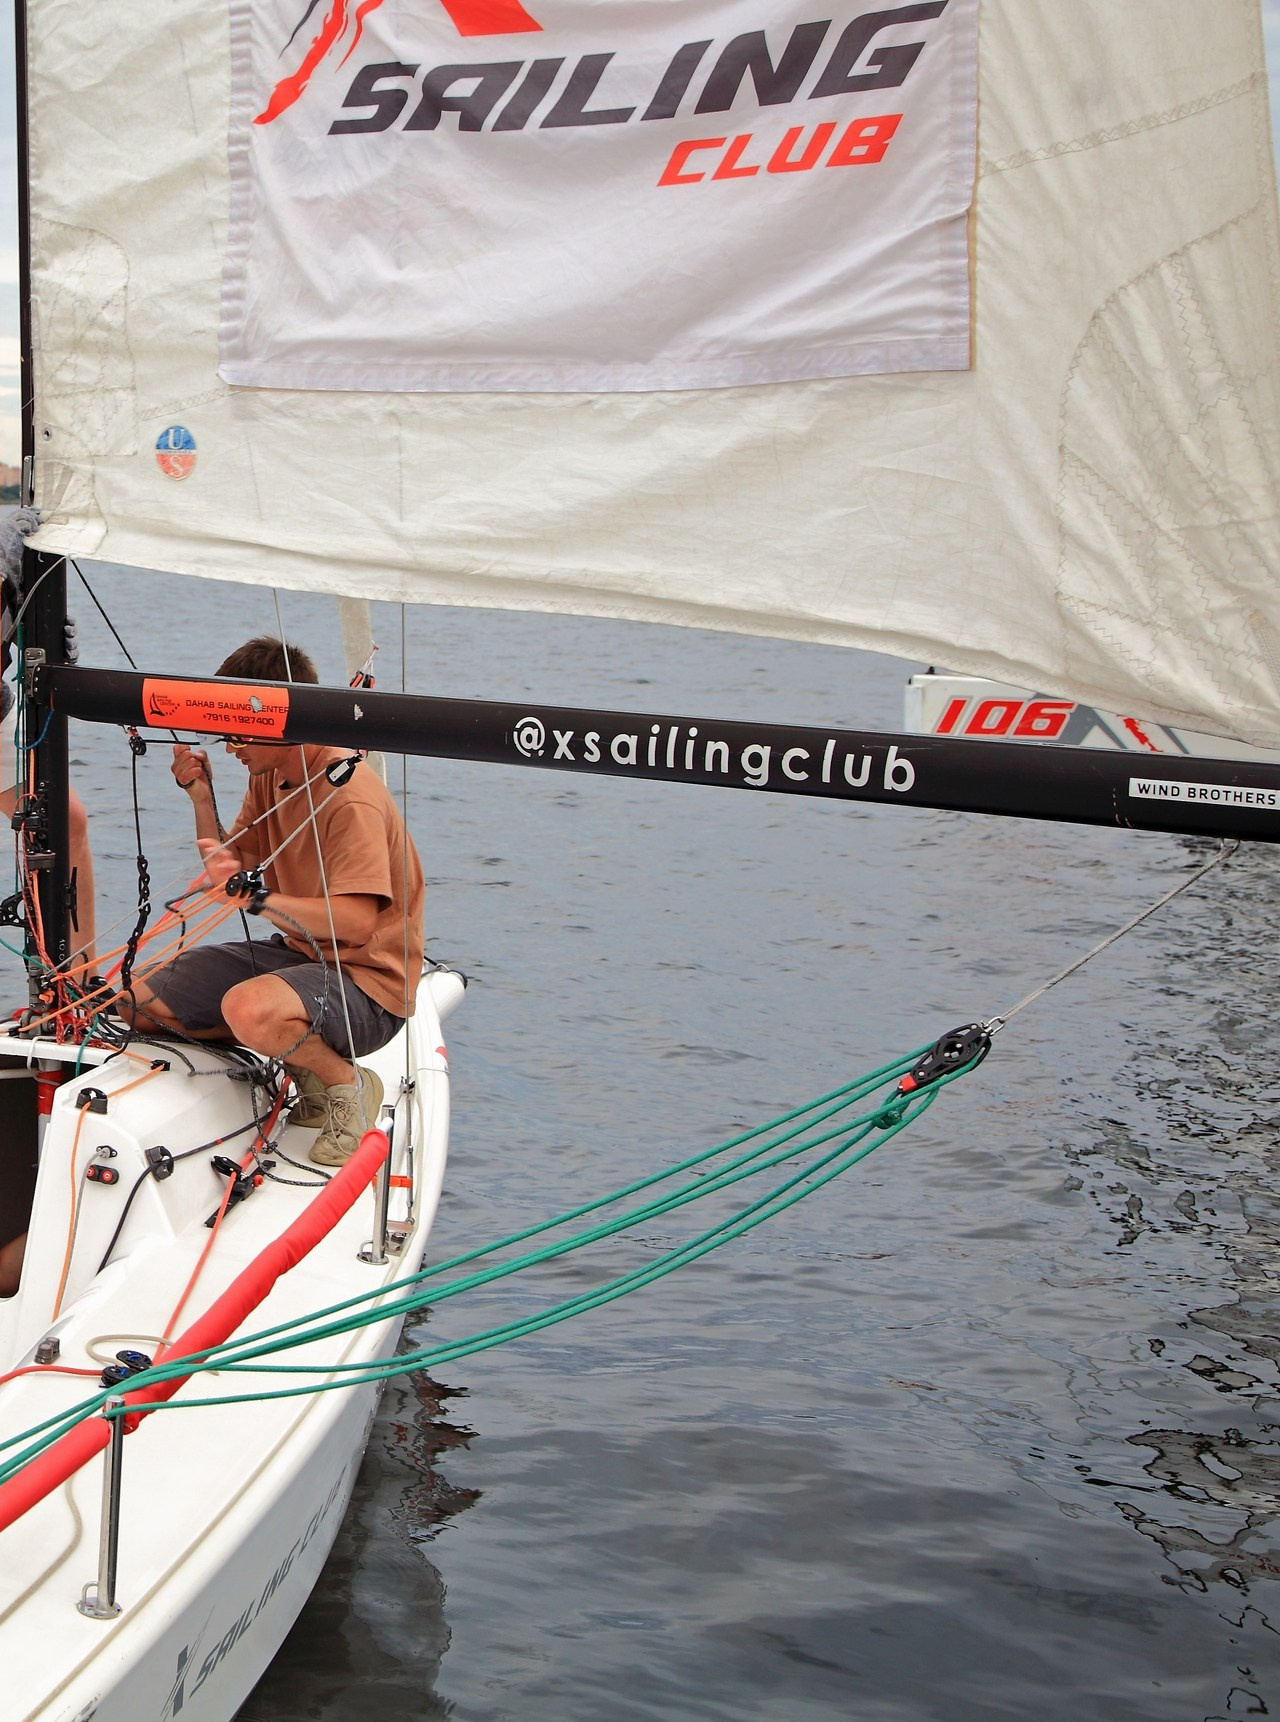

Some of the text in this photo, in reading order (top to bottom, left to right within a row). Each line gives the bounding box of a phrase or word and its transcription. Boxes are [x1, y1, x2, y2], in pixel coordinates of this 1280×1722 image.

[327, 0, 949, 135] SAILING
[656, 113, 904, 187] CLUB
[185, 699, 215, 709] DAHAB
[218, 702, 251, 712] SAILING
[232, 715, 275, 726] 1927400
[933, 695, 1076, 740] 106
[512, 716, 916, 793] @xsailingclub
[1137, 782, 1276, 806] WIND BROTHERS
[189, 1537, 301, 1700] SAILING
